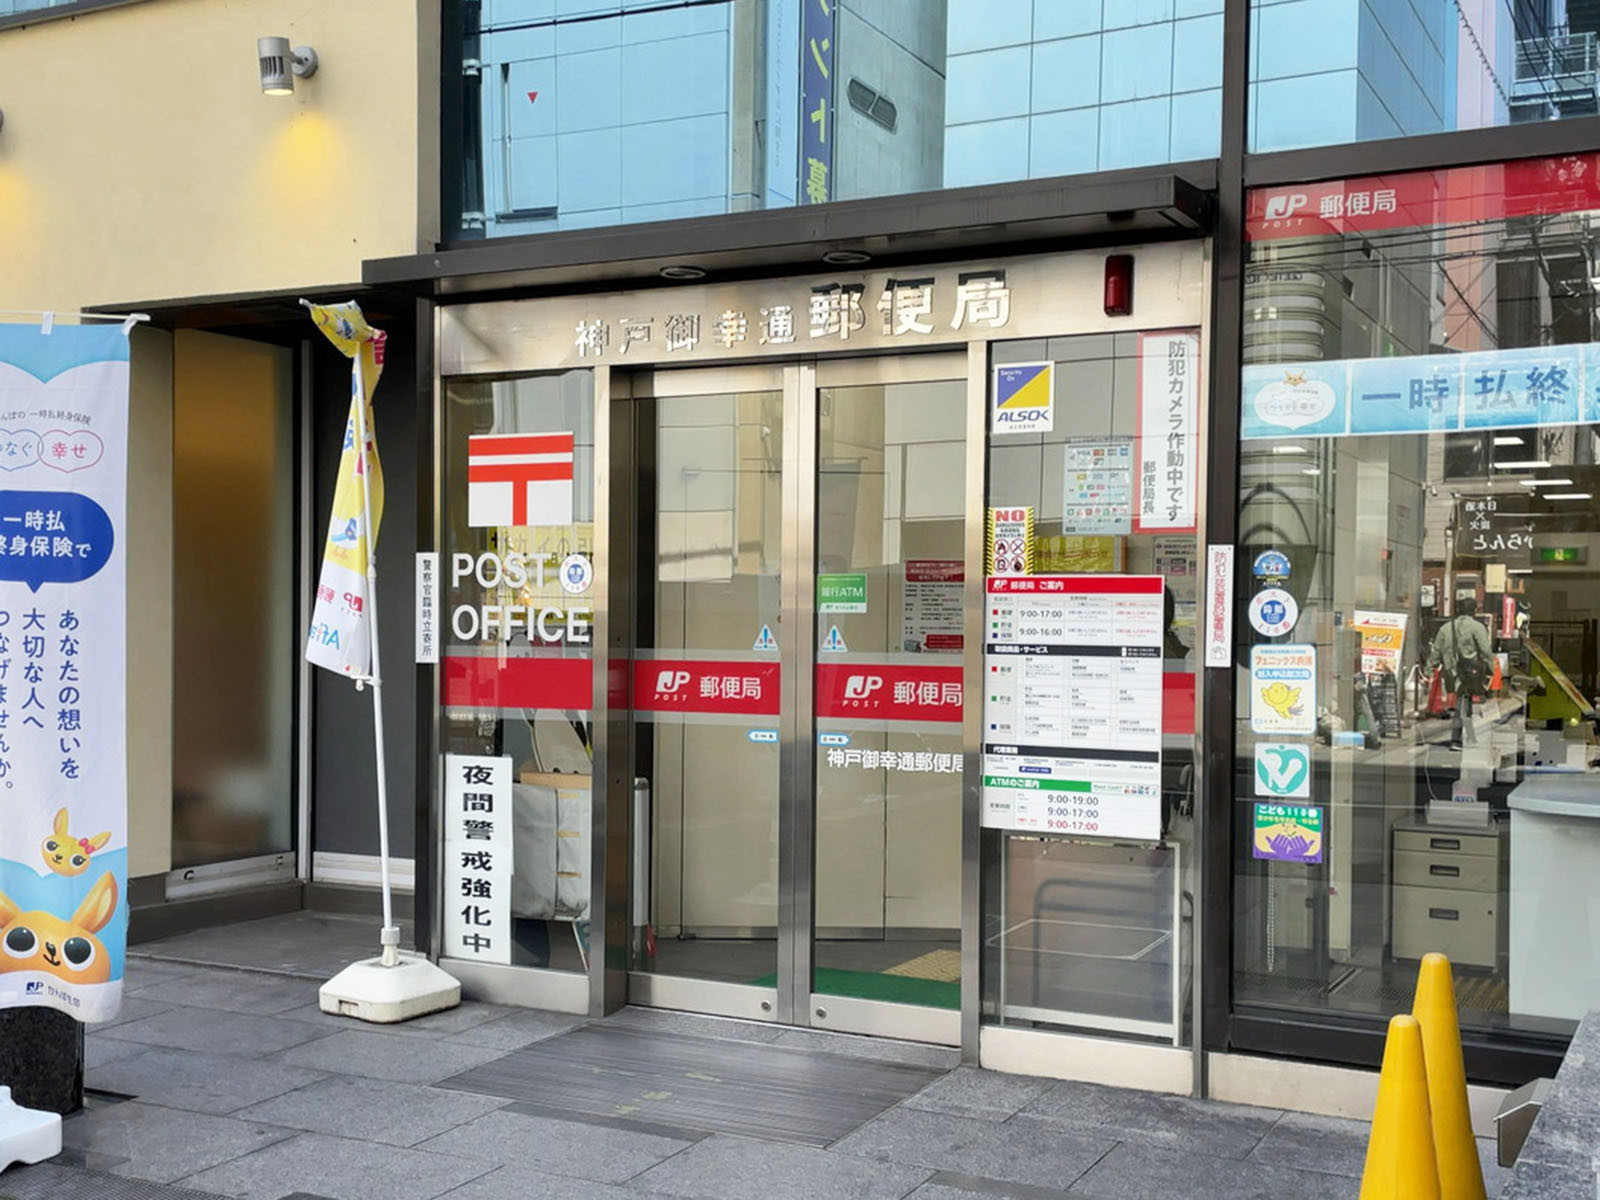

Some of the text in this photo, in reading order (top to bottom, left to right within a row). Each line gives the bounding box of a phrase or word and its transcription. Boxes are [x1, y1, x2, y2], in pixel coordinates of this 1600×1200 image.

[1319, 189, 1397, 219] 郵便局
[1261, 219, 1305, 229] POST
[575, 269, 1010, 358] 神戸御幸通郵便局
[997, 410, 1050, 422] ALSOK
[1167, 339, 1187, 523] 防犯カメラ作動中です
[0, 442, 88, 460] なぐ 幸せ
[1143, 460, 1157, 515] 郵便局長
[3, 510, 66, 532] 一時払
[995, 509, 1025, 522] NO
[451, 551, 554, 590] POST
[1039, 580, 1064, 590] ご案内
[451, 603, 592, 643] OFFICE
[1020, 610, 1063, 618] 9:00-17:00
[1019, 628, 1063, 636] 9:00-16:00
[22, 607, 47, 729] 大切な人へ
[59, 608, 82, 780] あなたの想いを
[700, 676, 762, 700] 郵便局
[893, 681, 963, 707] 郵便局
[654, 693, 688, 702] POST
[843, 699, 881, 708] POST
[990, 778, 1040, 789] ATMのご案内
[1048, 794, 1099, 806] 9:00-19:00
[1048, 806, 1099, 819] 9:00-17:00
[1048, 819, 1099, 831] 9:00-17:00
[460, 764, 495, 954] 夜間警戒強化中
